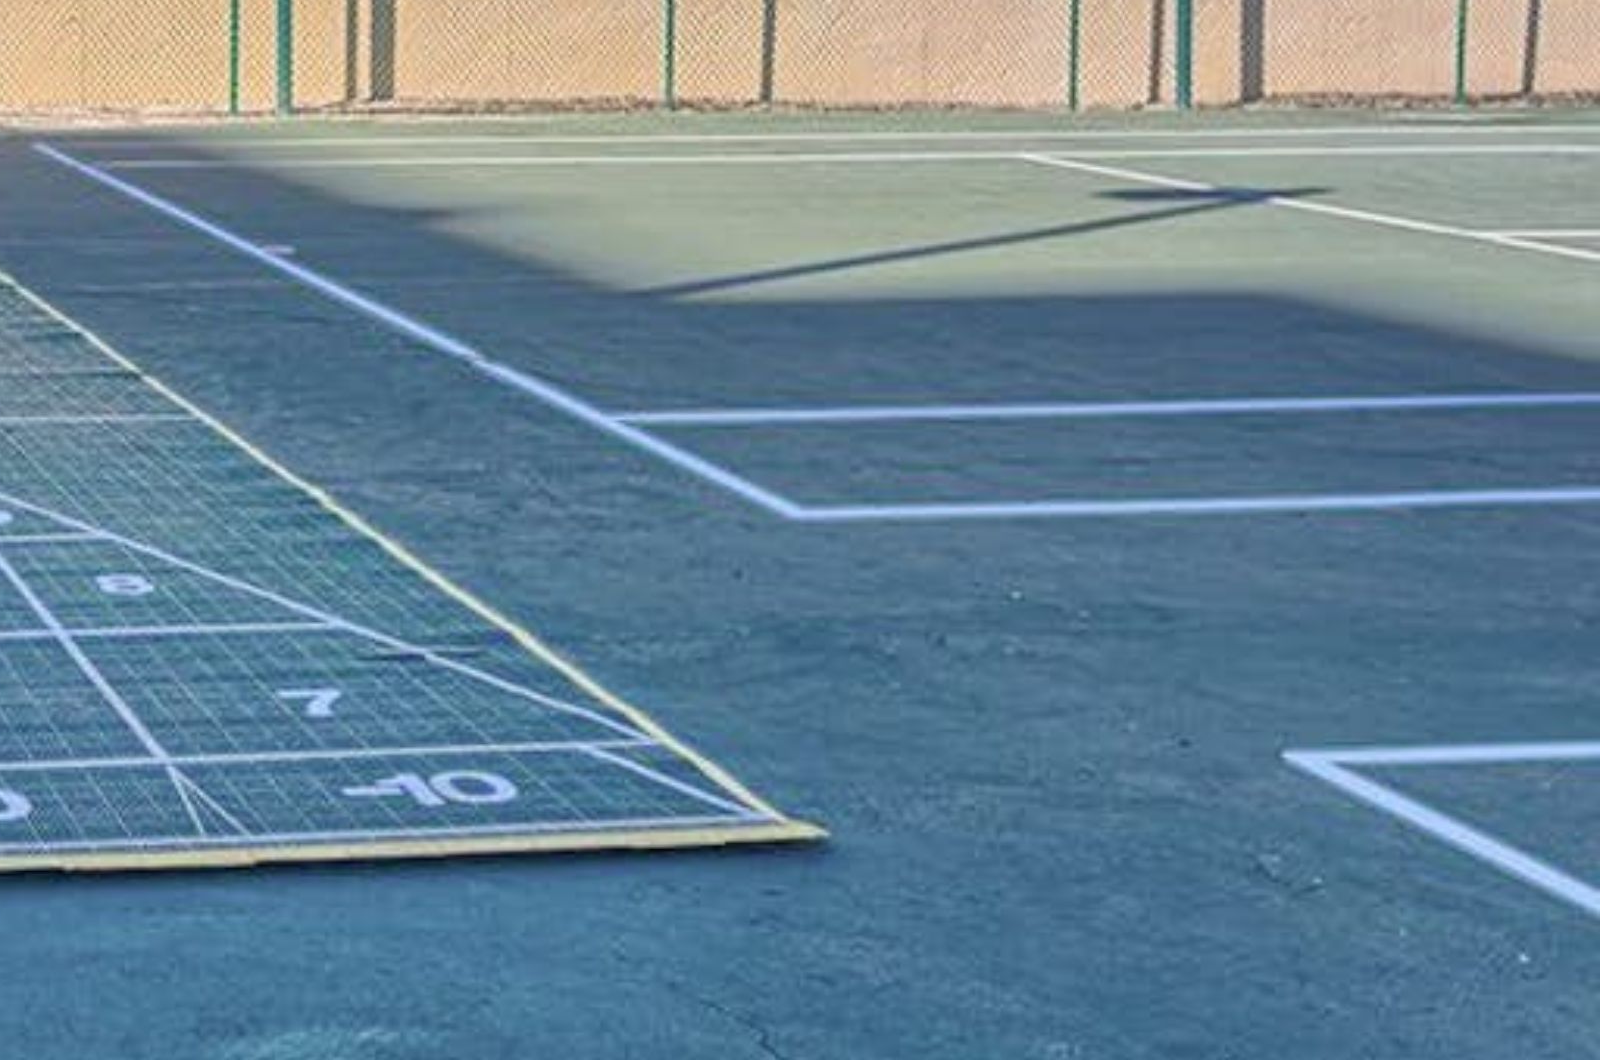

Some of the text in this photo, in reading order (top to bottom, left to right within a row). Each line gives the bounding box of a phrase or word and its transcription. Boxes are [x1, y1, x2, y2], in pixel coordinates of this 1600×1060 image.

[95, 573, 155, 596] 8
[278, 687, 342, 718] 7
[341, 770, 518, 807] -10
